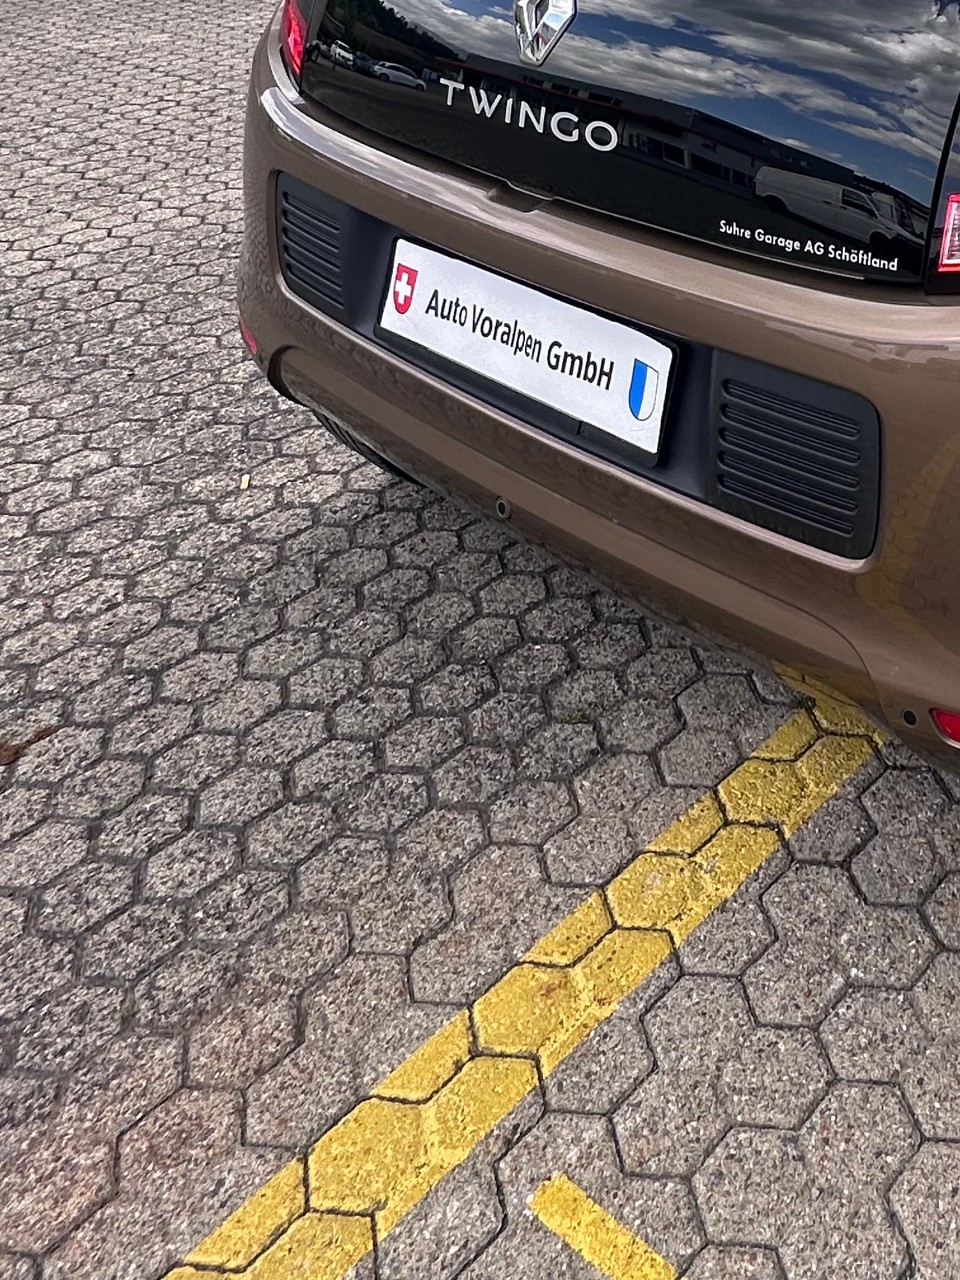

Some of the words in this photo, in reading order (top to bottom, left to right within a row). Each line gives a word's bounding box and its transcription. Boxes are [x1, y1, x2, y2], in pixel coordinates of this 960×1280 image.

[439, 77, 619, 152] TWINGO
[719, 219, 751, 239] Suhre
[755, 228, 801, 252] Garage
[804, 240, 825, 255] AG
[828, 245, 899, 271] Schöftland
[425, 289, 468, 327] Auto
[472, 304, 542, 362] Voralpen
[546, 340, 614, 391] GmbH
